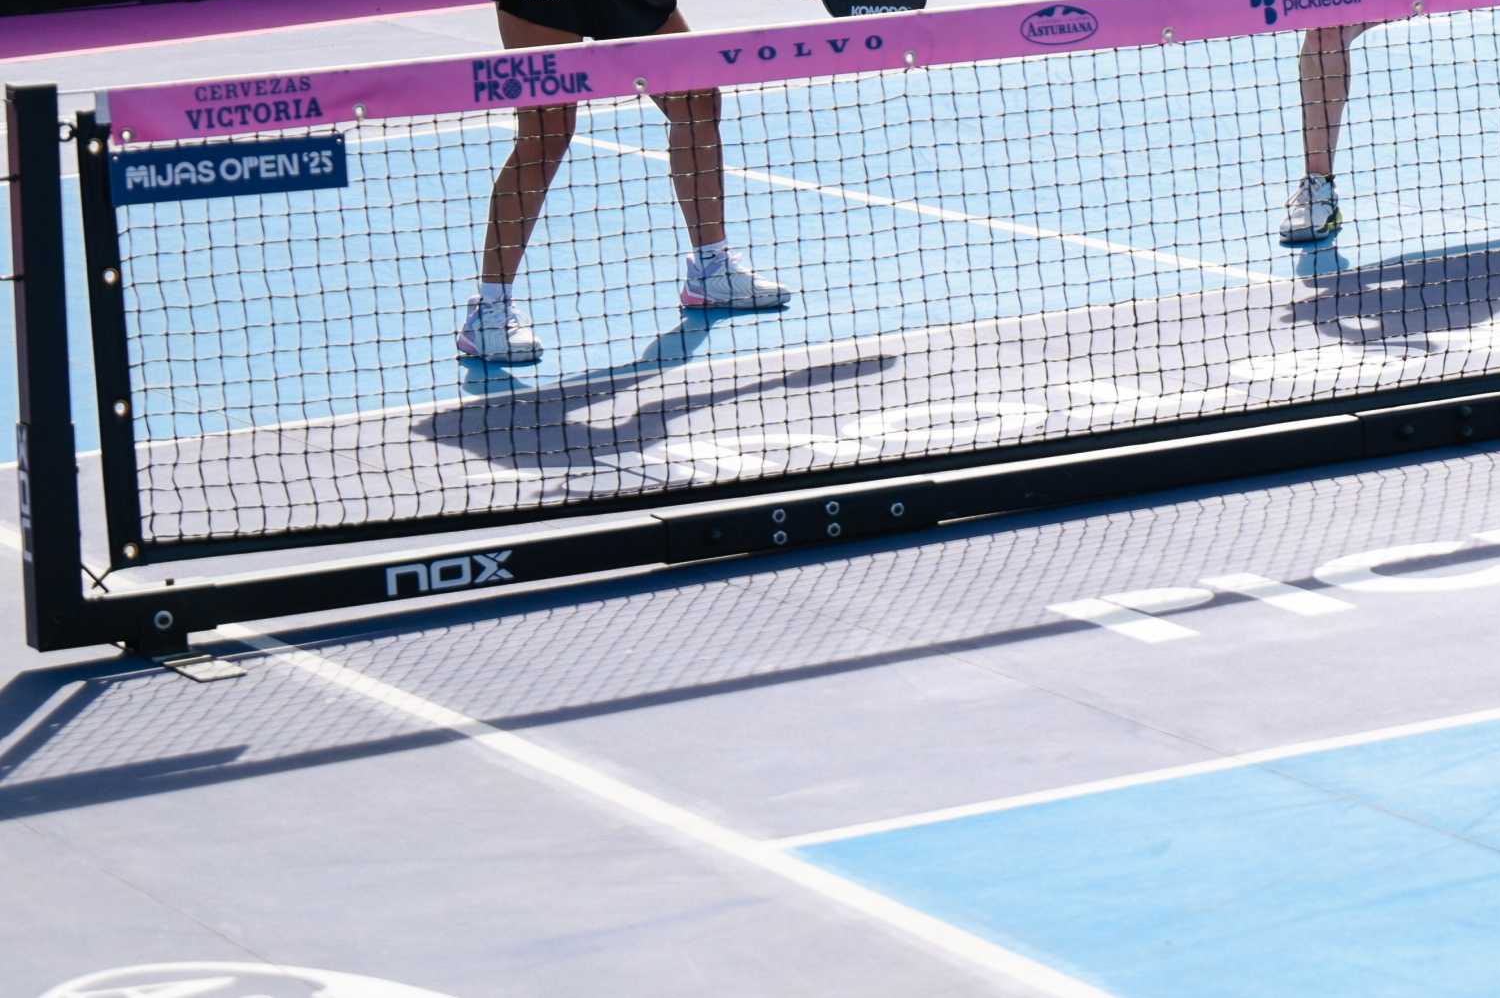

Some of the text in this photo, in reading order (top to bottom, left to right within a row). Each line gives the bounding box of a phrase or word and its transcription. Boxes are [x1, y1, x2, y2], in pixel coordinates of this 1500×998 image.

[1027, 21, 1093, 37] ASTURIANA
[718, 34, 884, 65] VOLVO
[195, 76, 312, 102] CERVEZAS
[185, 97, 323, 130] VICTORIA
[125, 160, 216, 190] MIJAS
[219, 152, 300, 181] OPEN
